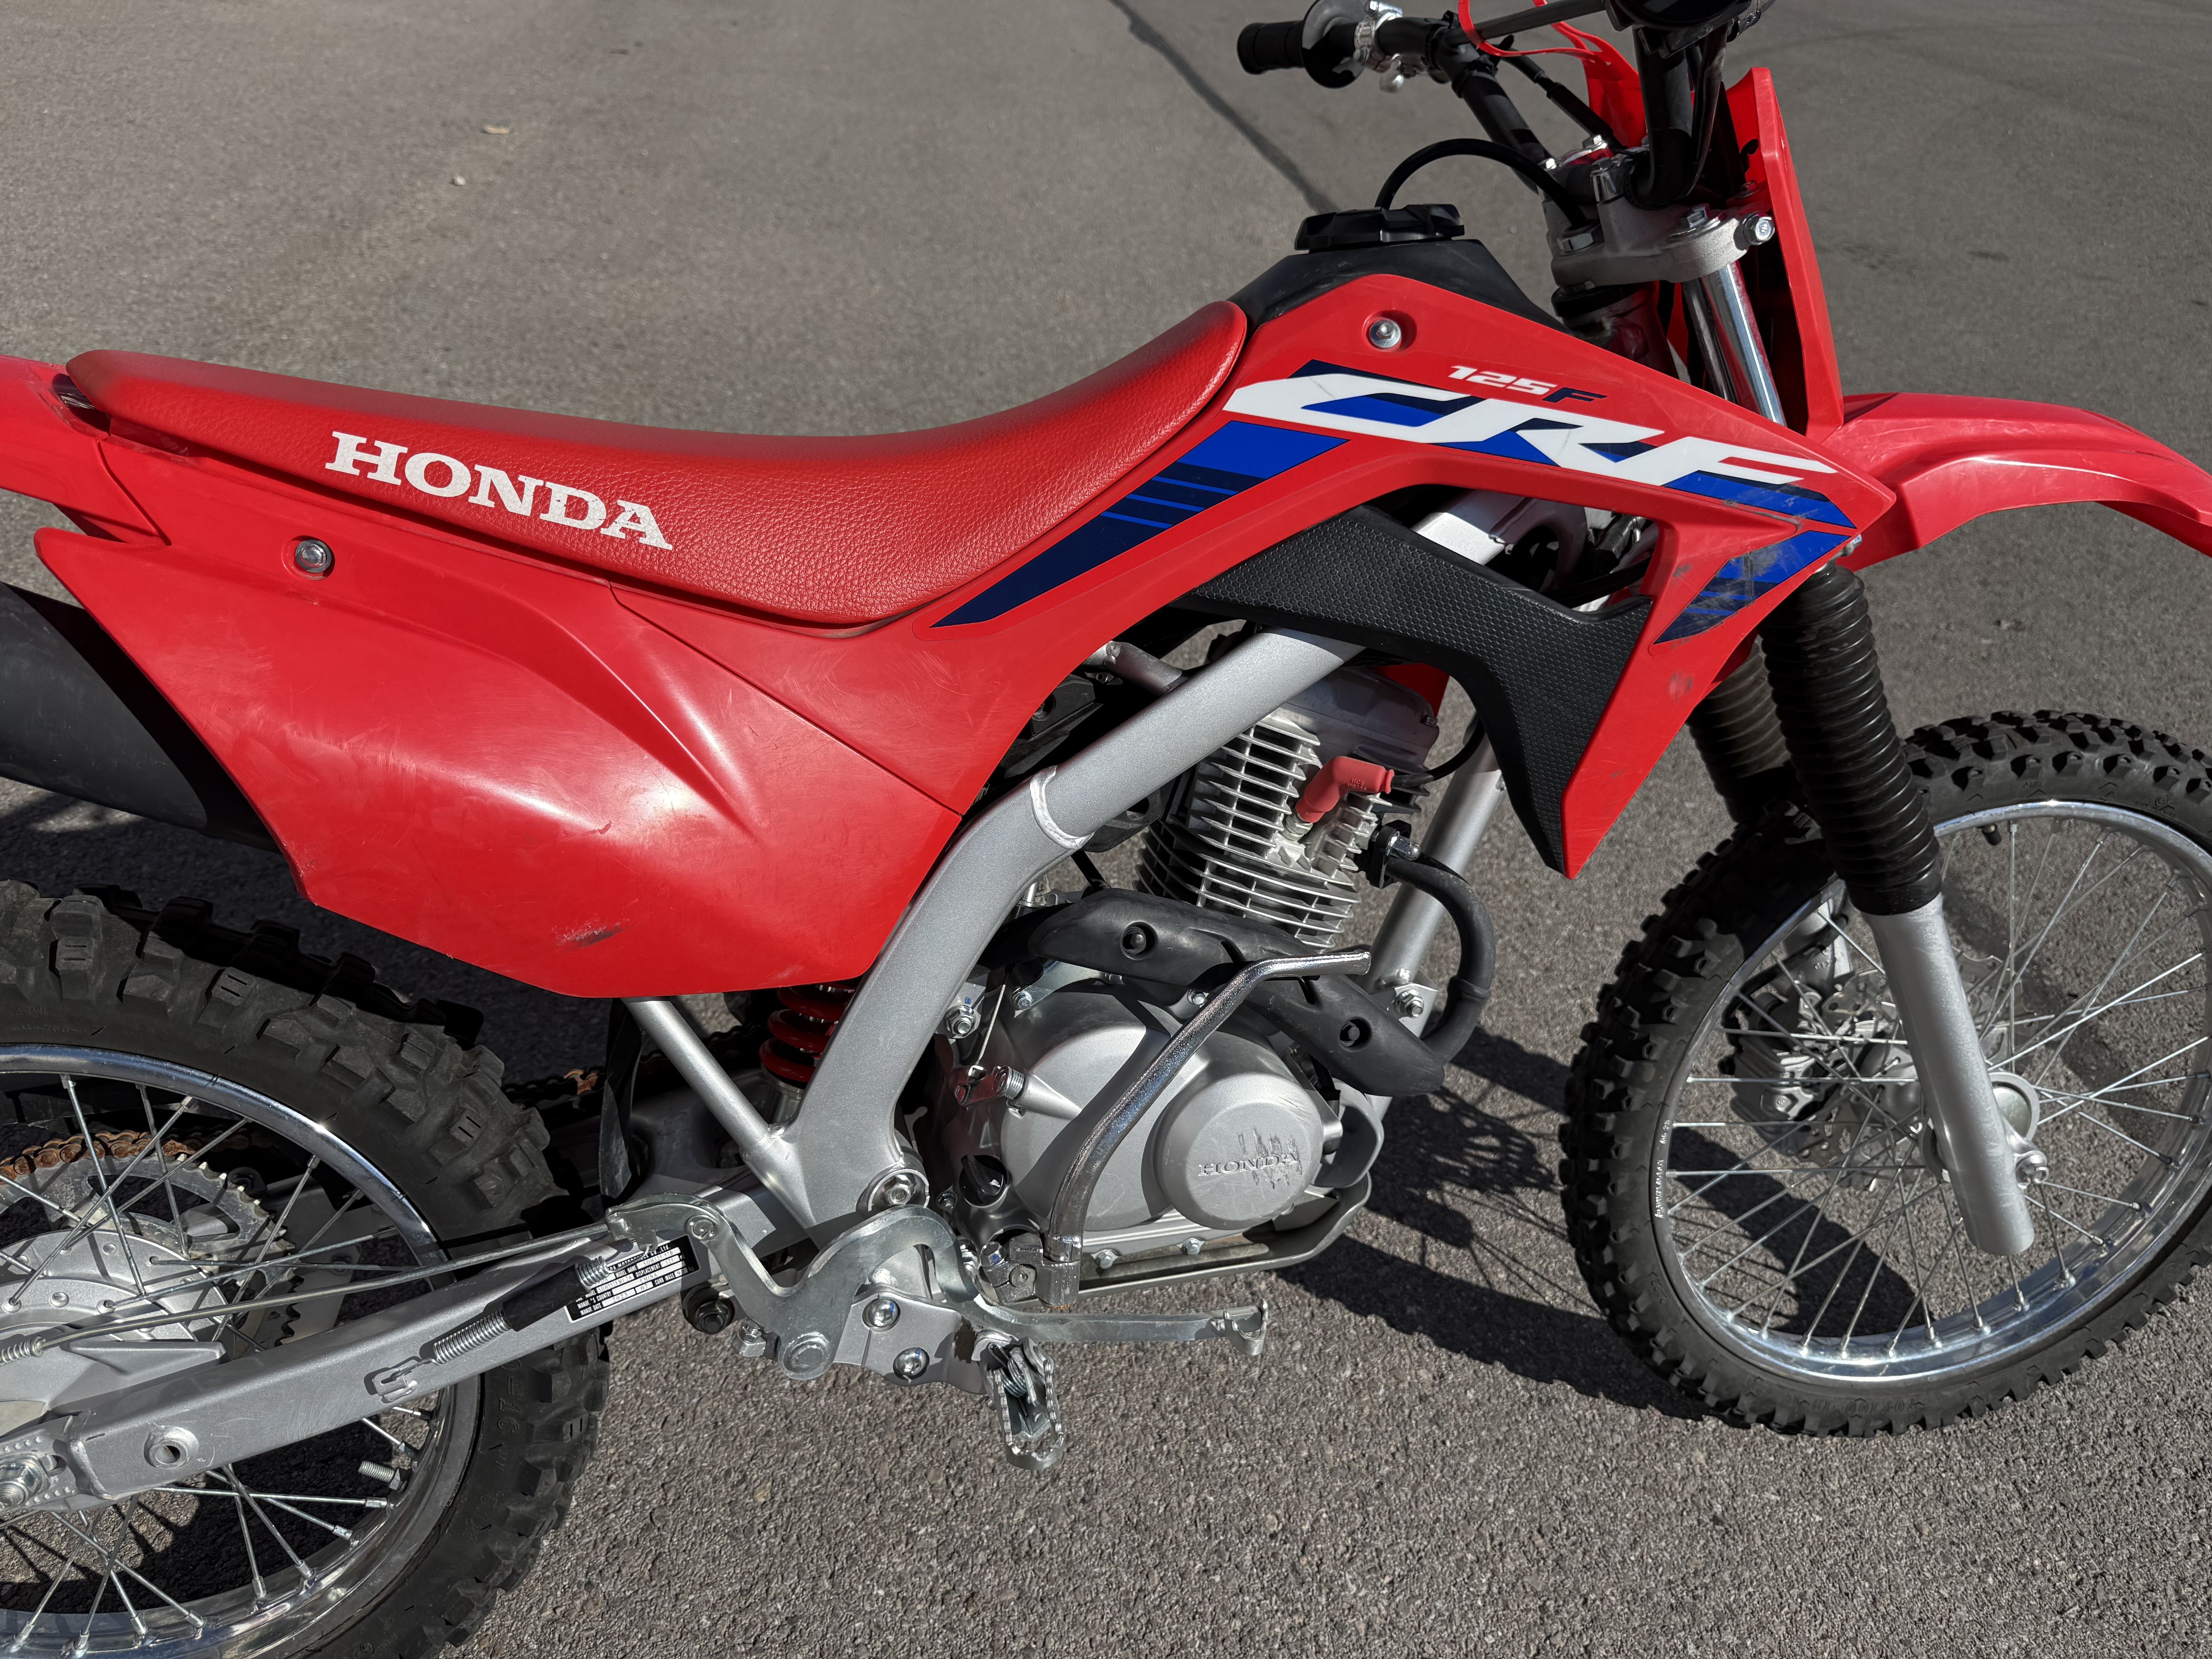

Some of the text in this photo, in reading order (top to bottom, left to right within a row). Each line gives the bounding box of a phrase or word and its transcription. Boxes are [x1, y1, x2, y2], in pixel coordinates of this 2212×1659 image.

[1222, 373, 1838, 486] CRF
[325, 431, 672, 550] HONDA
[1198, 1152, 1300, 1176] HONDA
[635, 1264, 661, 1277] DISPLACEMENT
[597, 1291, 612, 1301] COUNTRY
[640, 1273, 658, 1283] CHINA
[613, 1293, 628, 1302] 2023
[665, 1273, 675, 1281] MASS
